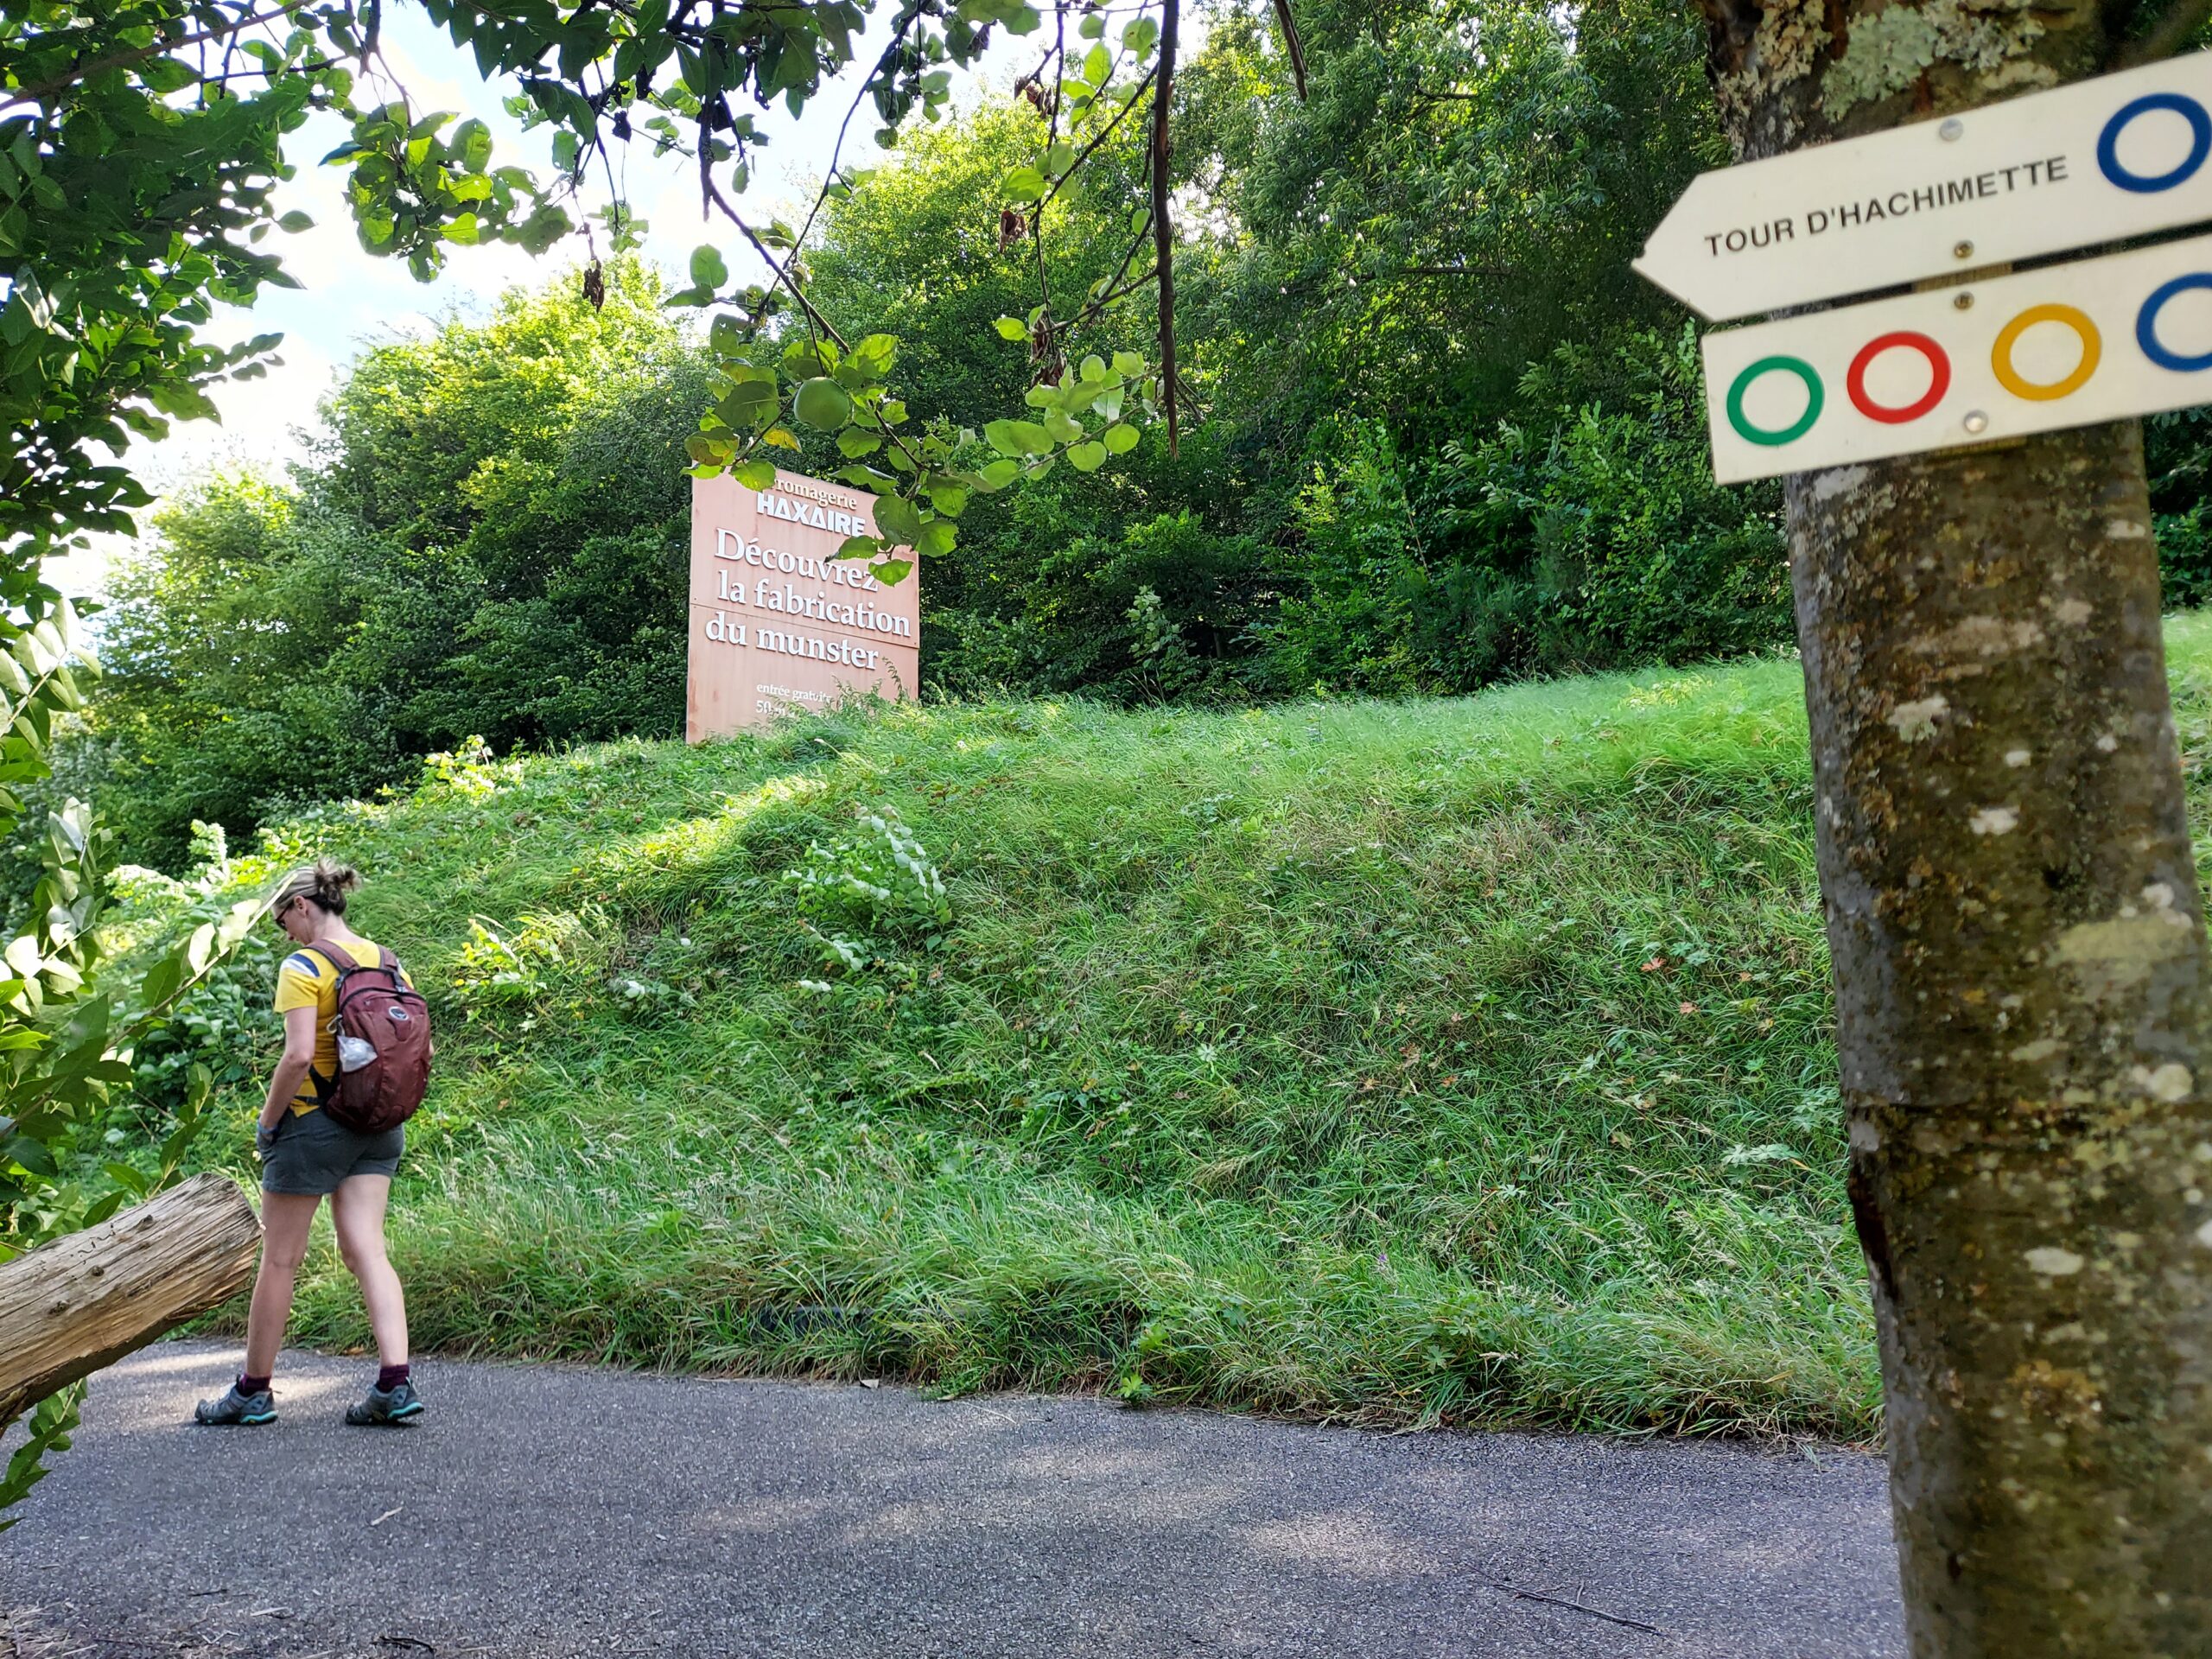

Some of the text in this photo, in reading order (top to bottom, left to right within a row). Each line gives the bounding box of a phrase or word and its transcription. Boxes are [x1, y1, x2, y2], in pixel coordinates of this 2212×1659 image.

[1704, 156, 2069, 257] TOUR D'HACHIMETTE
[757, 493, 866, 537] HAXAIRE
[771, 479, 858, 510] romagerie
[714, 528, 879, 593] Découvrez
[718, 569, 911, 637] la fabrication
[705, 612, 879, 670] du munster
[756, 683, 790, 696] entrée
